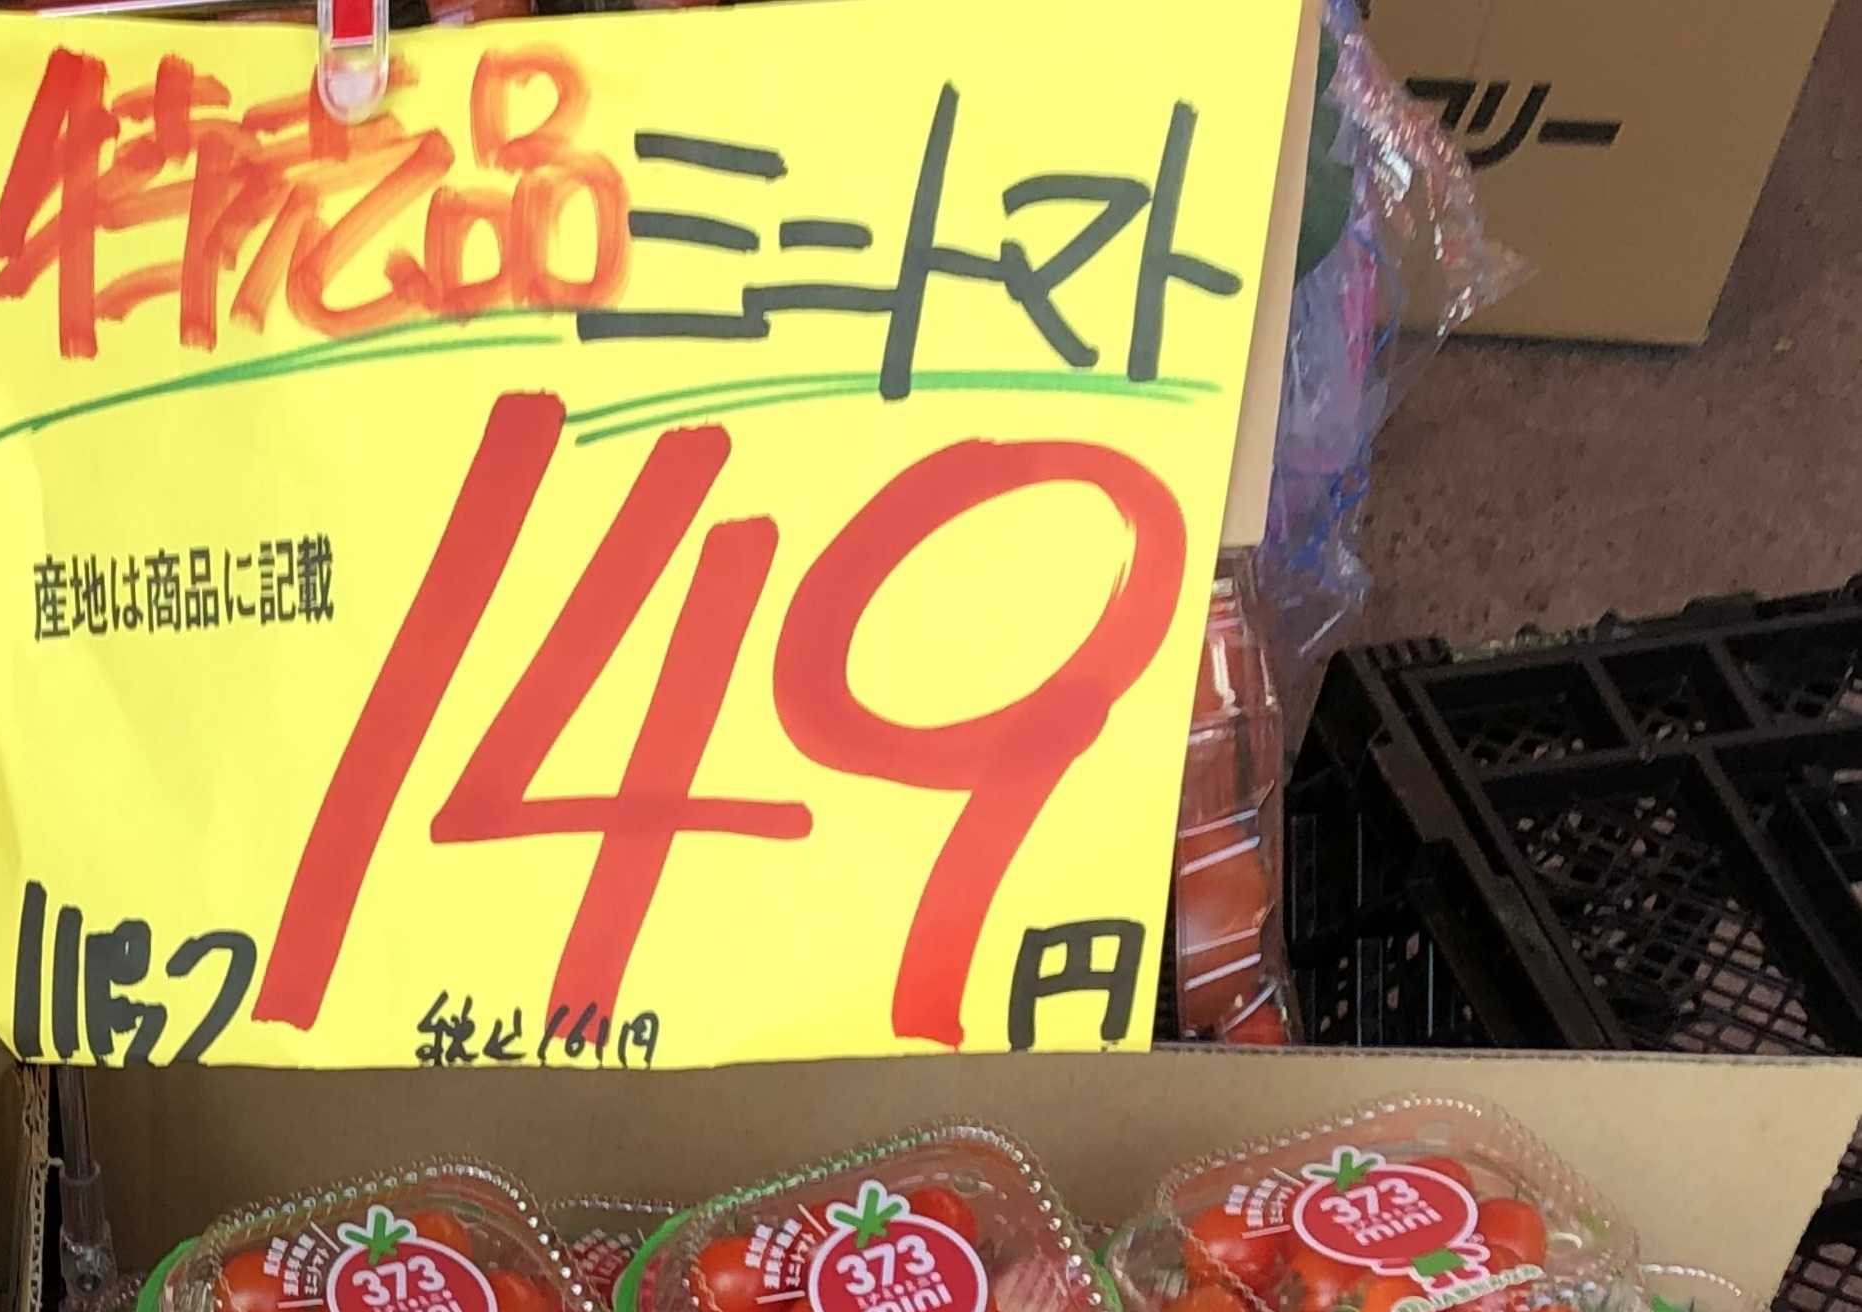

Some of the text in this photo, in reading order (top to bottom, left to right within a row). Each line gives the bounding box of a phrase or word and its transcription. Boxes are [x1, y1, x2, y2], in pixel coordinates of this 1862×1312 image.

[575, 81, 1243, 400] ミニトマト
[33, 532, 336, 644] 産地は商品に記載
[252, 388, 1188, 1051] 149
[1320, 1178, 1420, 1224] 373
[1354, 1200, 1443, 1246] mini
[352, 1255, 445, 1306] 373
[836, 1234, 936, 1296] 373
